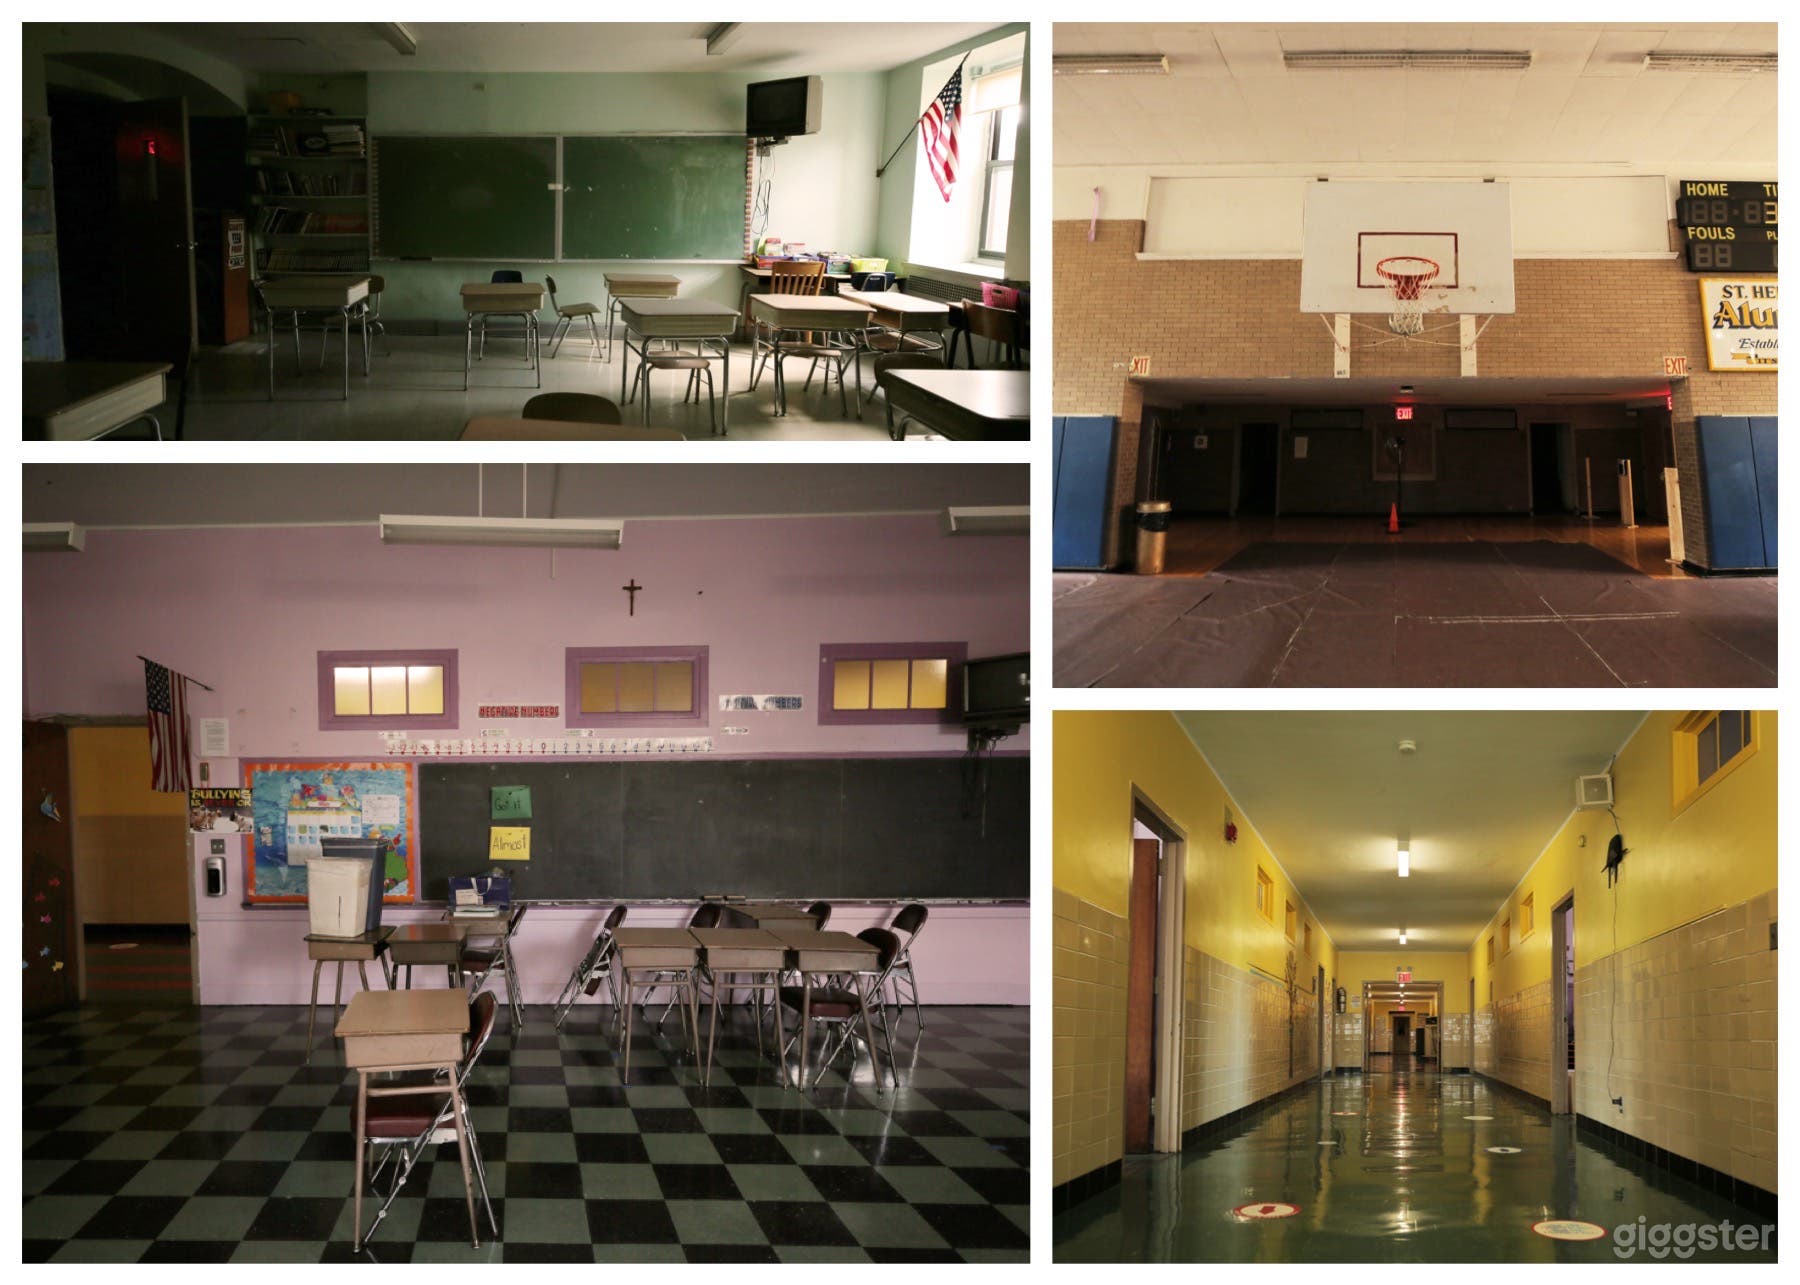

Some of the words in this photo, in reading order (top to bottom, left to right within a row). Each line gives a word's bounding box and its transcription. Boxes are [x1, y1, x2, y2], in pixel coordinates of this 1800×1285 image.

[1686, 183, 1728, 196] HOME
[1763, 184, 1778, 197] TI
[1687, 226, 1736, 240] FOULS
[1722, 284, 1748, 298] ST.
[1752, 285, 1778, 299] HE
[1712, 300, 1778, 330] Alu
[1664, 357, 1686, 375] EXIT
[1397, 407, 1412, 420] EXIT
